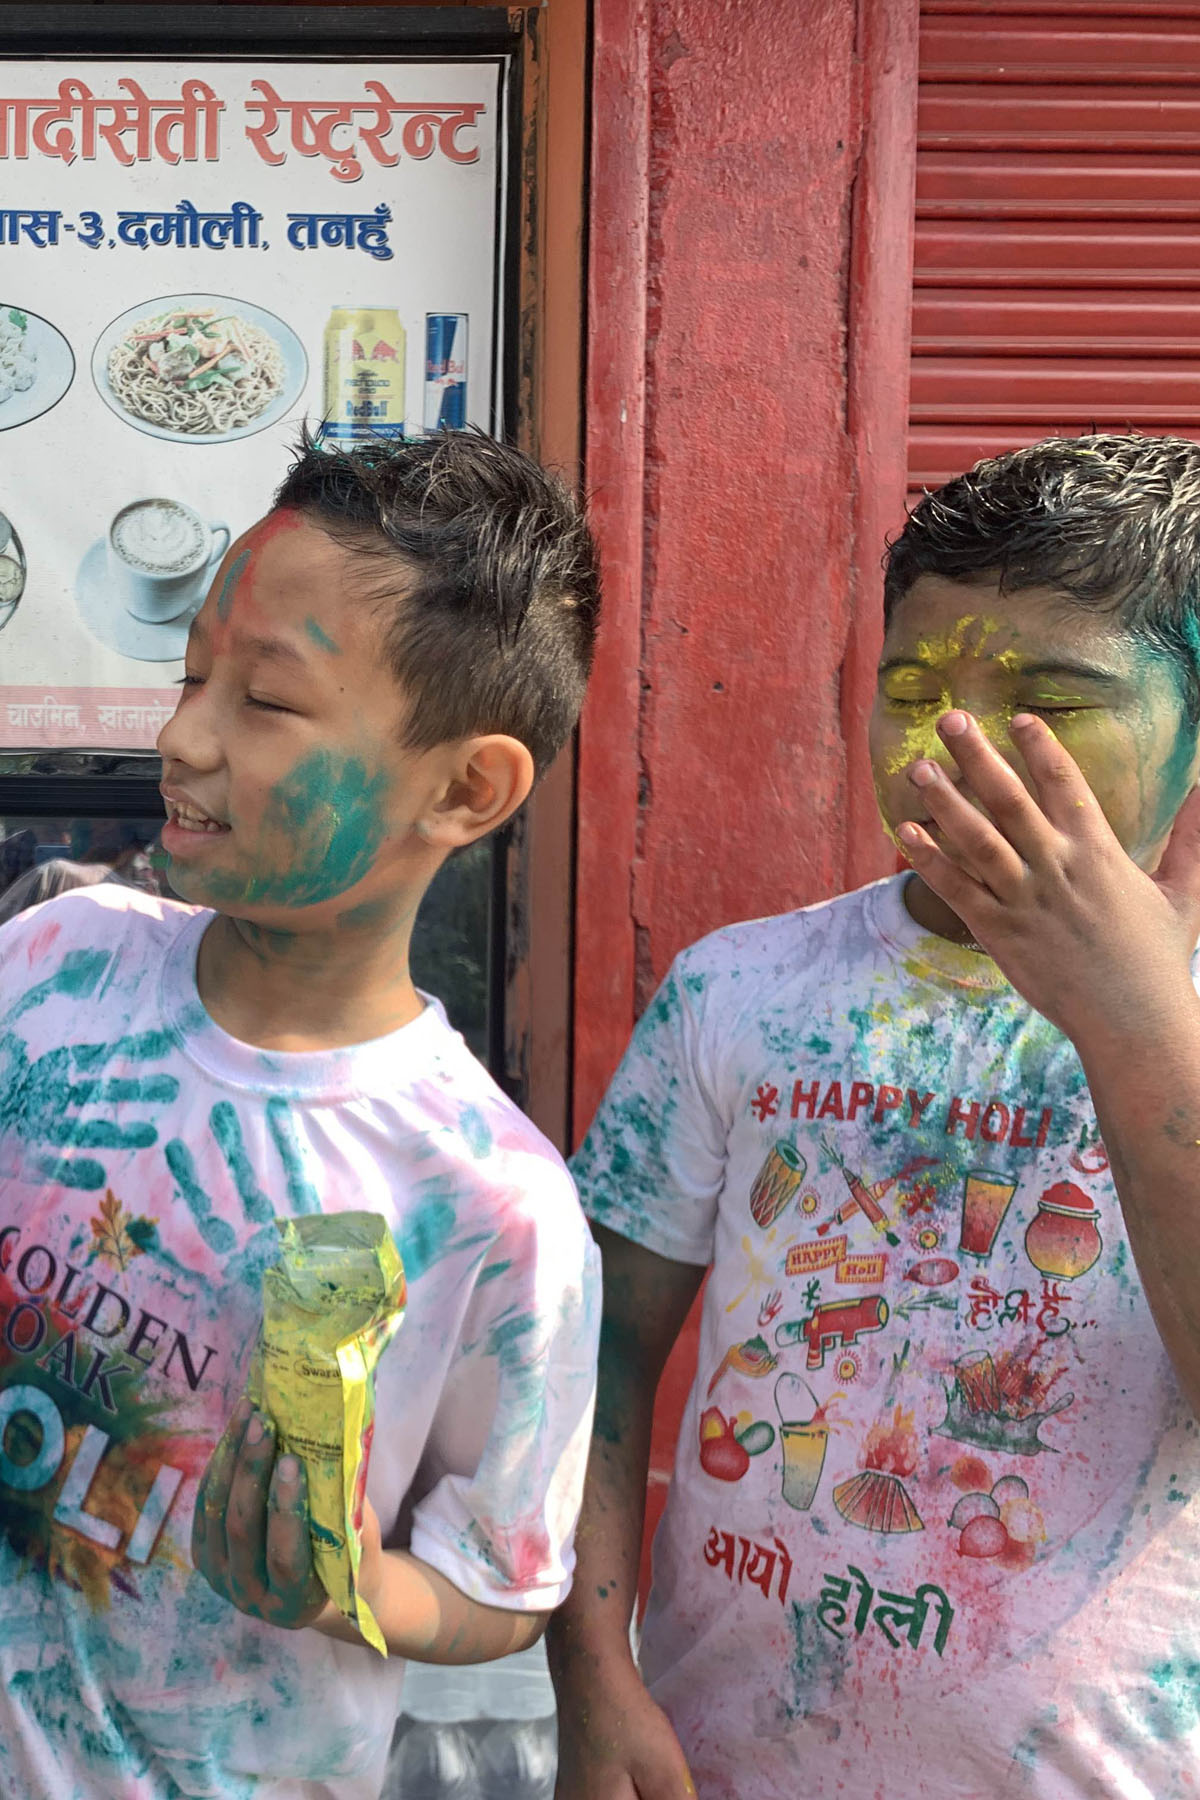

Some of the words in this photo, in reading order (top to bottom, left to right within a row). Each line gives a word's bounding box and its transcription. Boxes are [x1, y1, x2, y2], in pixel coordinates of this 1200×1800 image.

[789, 1079, 936, 1129] HAPPY
[946, 1096, 1053, 1148] HOLI
[791, 1246, 840, 1266] HAPPY
[6, 1302, 135, 1414] OAK
[302, 1364, 341, 1379] Swara
[703, 1526, 793, 1607] आयो
[816, 1564, 955, 1657] होली
